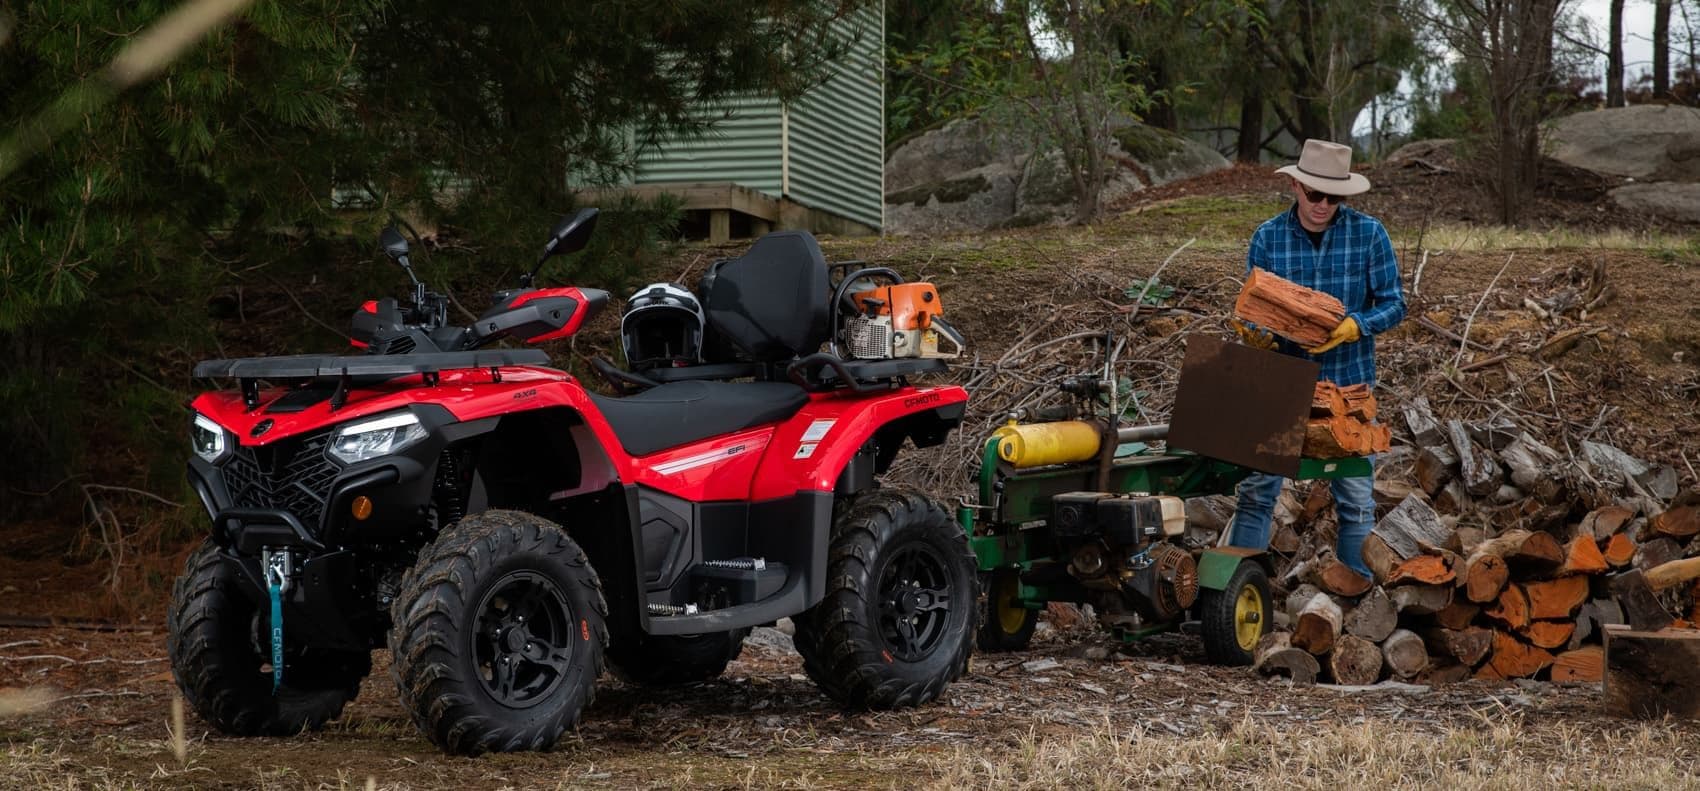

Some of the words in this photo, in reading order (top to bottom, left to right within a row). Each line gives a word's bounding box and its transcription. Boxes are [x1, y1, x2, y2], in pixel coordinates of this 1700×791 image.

[904, 394, 940, 409] CFMOTO
[728, 445, 746, 455] EFI
[273, 627, 283, 680] CFMOTO
